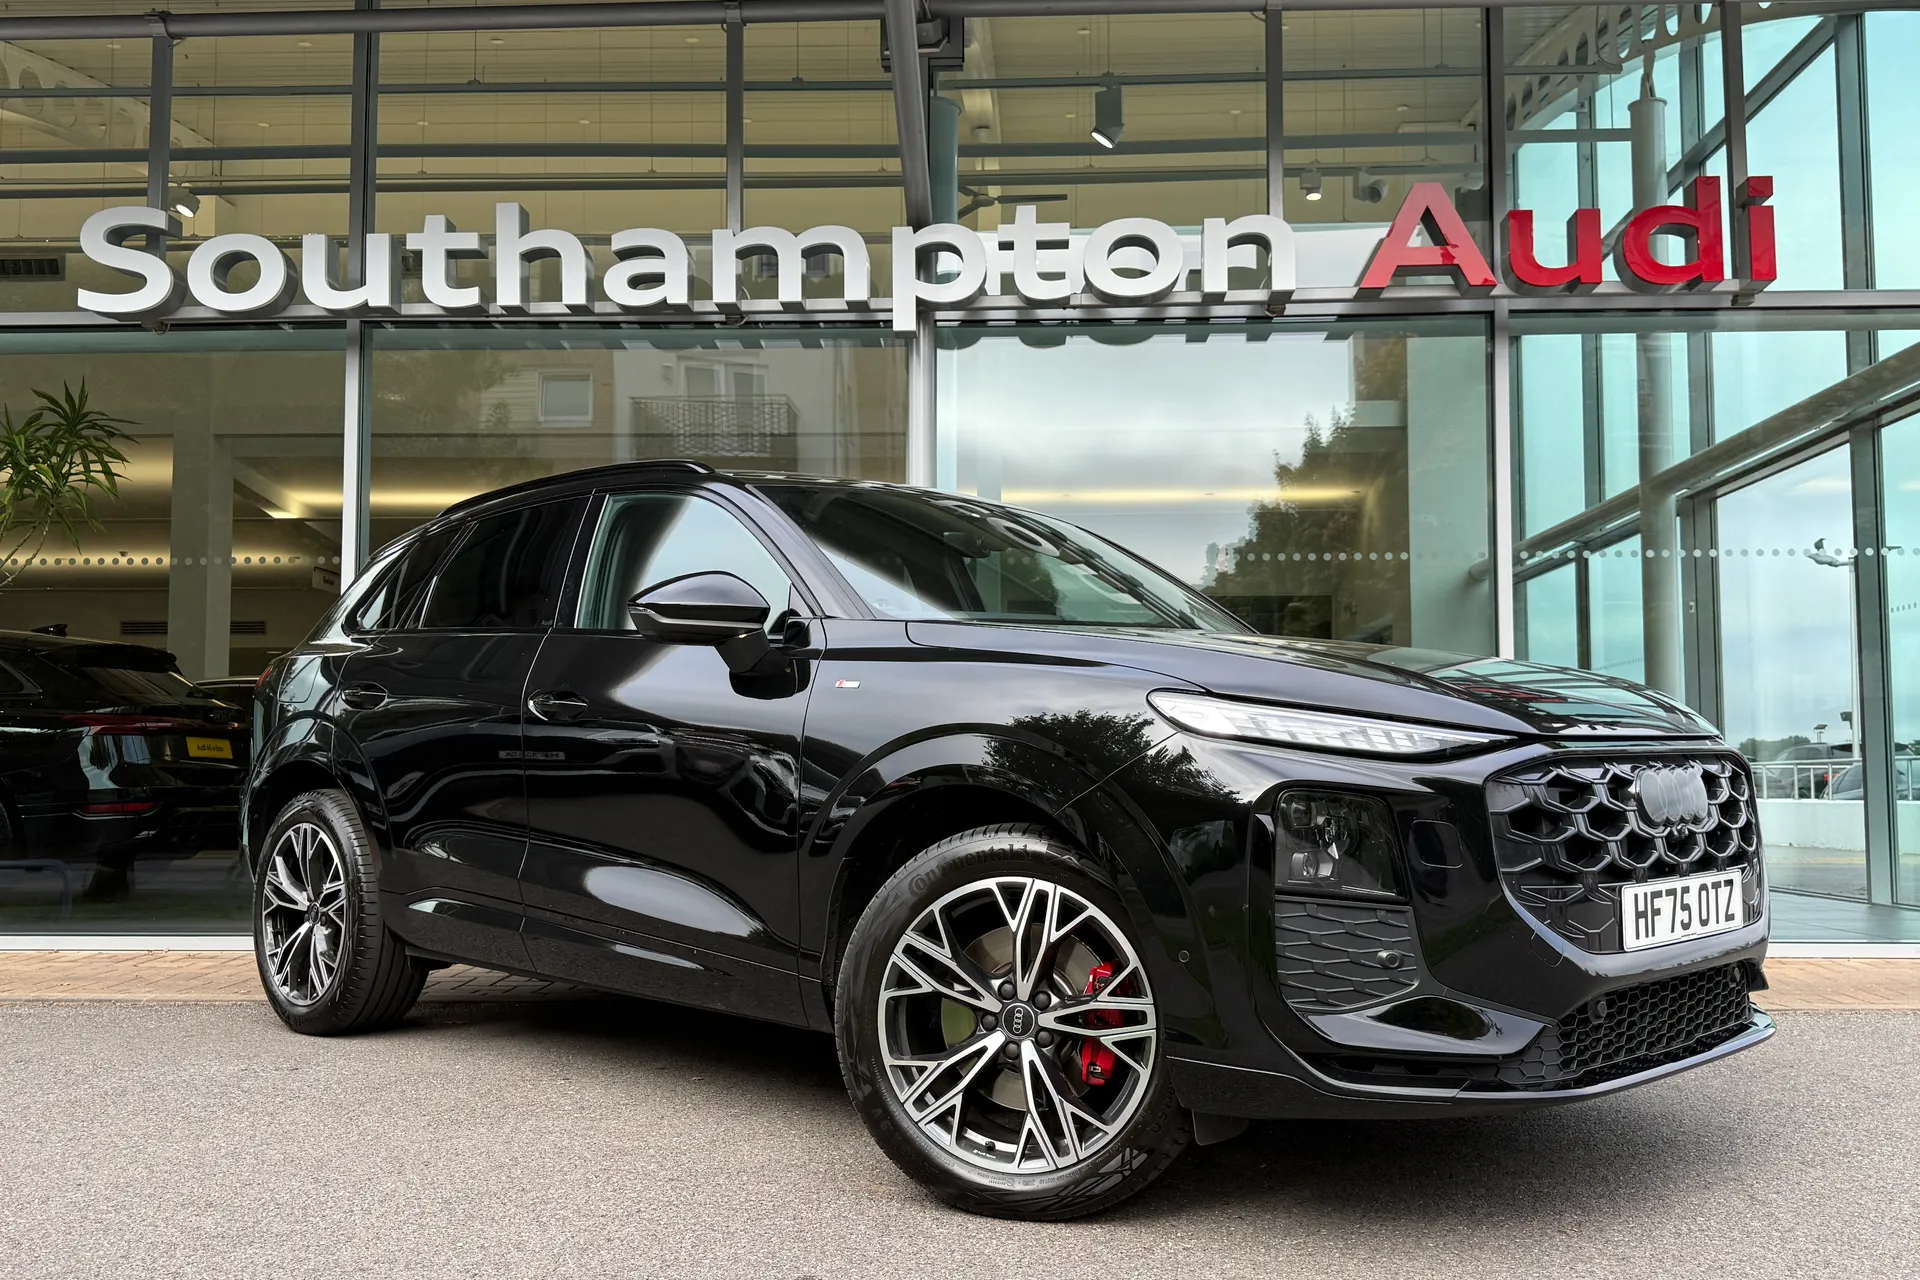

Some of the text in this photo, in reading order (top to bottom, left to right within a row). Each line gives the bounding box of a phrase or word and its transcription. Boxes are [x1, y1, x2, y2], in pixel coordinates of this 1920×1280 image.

[77, 175, 1778, 333] Southampton Audi
[1634, 878, 1735, 940] HF75 OTZ
